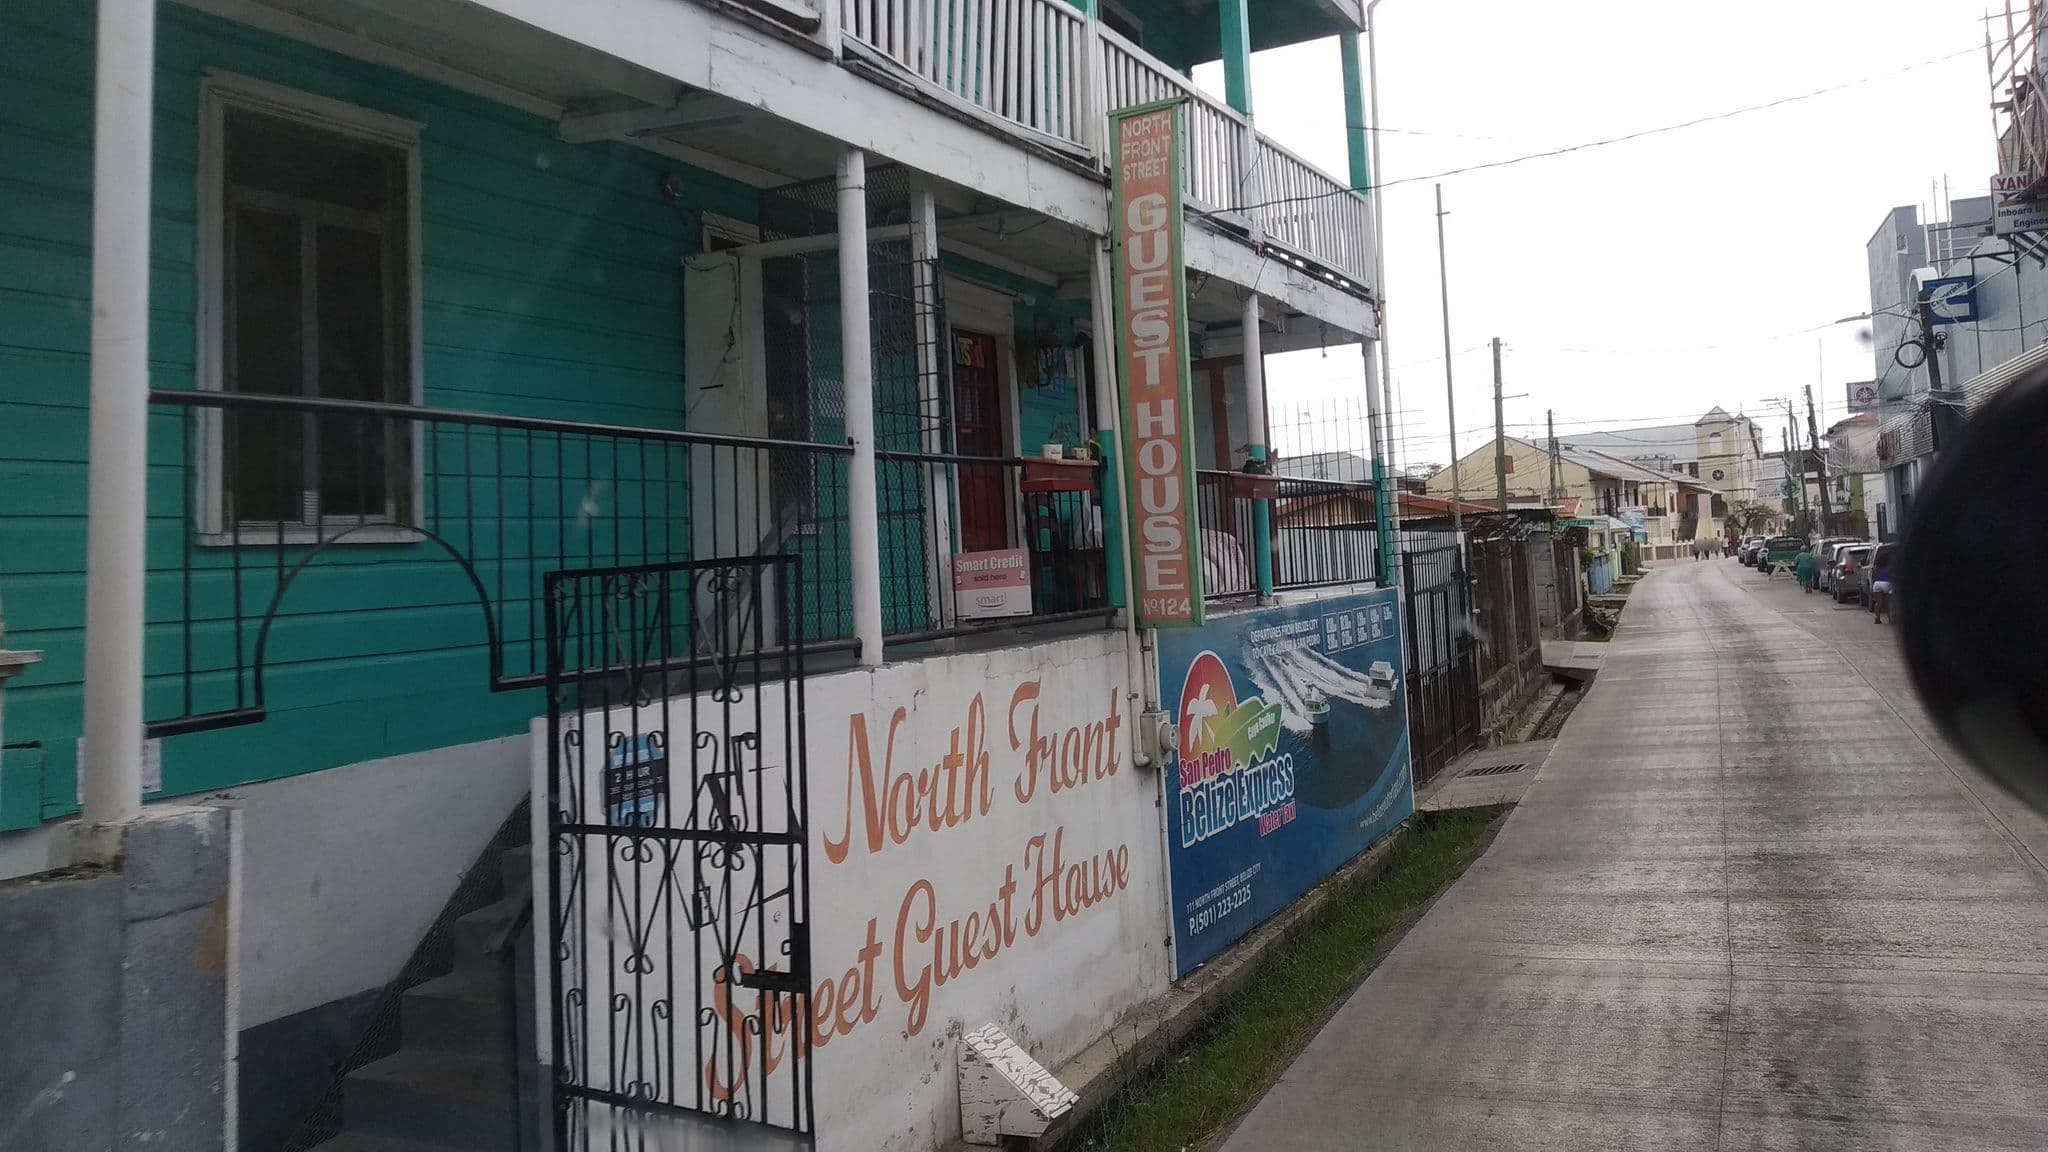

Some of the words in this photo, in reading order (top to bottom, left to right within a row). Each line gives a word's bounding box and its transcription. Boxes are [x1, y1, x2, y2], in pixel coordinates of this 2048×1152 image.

[1121, 135, 1170, 160] FRONT
[1122, 113, 1171, 140] NORTH
[1123, 157, 1168, 181] STREET
[1996, 175, 2028, 190] YAN
[1127, 192, 1171, 385] GUEST
[1136, 399, 1185, 591] HOUSE
[957, 558, 988, 572] Smart
[990, 555, 1023, 570] Credit
[974, 574, 989, 582] sold
[990, 573, 1007, 581] here
[823, 692, 994, 864] North
[1008, 681, 1121, 804] Front
[1179, 758, 1201, 789] San
[1202, 747, 1232, 780] Pedro
[1180, 777, 1236, 848] Belize
[1236, 753, 1295, 822] Express
[1259, 808, 1281, 837] Water
[1281, 798, 1297, 825] Taxi
[1186, 899, 1196, 915] 111
[1195, 891, 1212, 910] NORTH
[1211, 882, 1225, 900] FRONT
[1239, 866, 1254, 884] BELIZE
[1253, 862, 1262, 876] CITY
[1189, 903, 1217, 937] P.(501)
[1217, 883, 1252, 920] 223-2225
[704, 916, 883, 1100] Street
[893, 864, 1018, 1037] Guest
[1024, 826, 1130, 938] House
